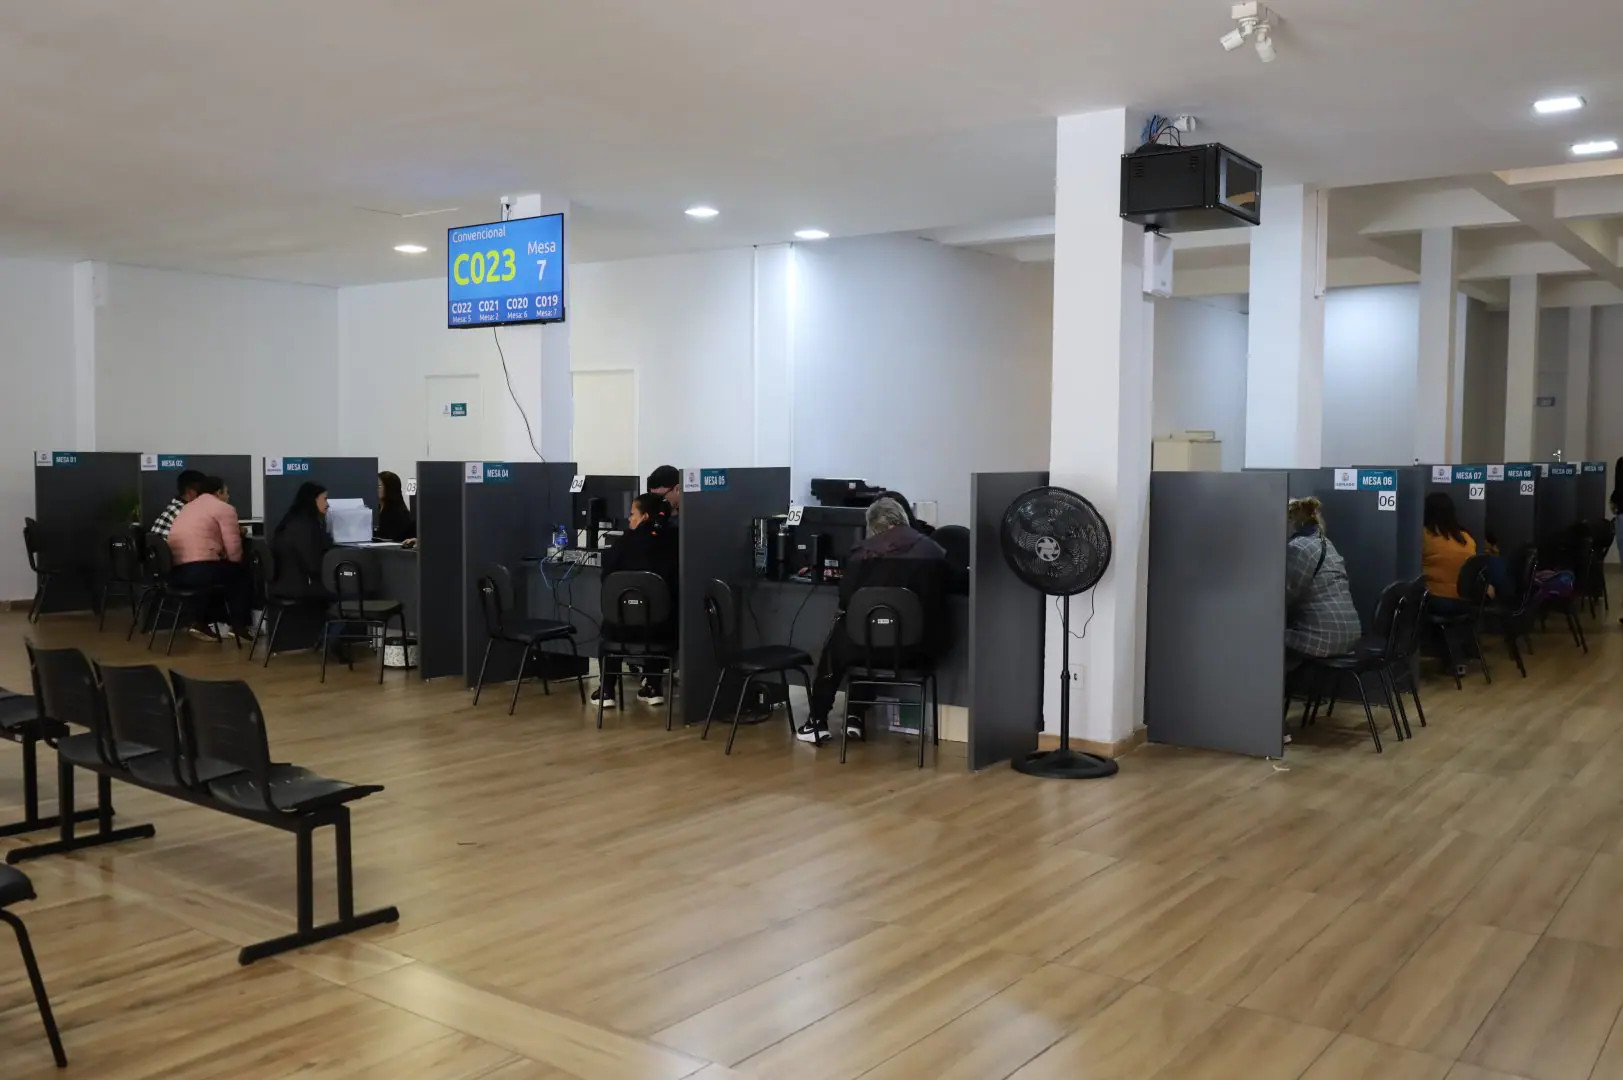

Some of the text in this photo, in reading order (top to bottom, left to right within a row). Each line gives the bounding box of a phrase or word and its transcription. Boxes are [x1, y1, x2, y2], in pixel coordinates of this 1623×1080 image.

[452, 224, 506, 243] Convencional
[527, 240, 556, 256] Mesa
[453, 248, 516, 286] C023
[536, 259, 547, 281] 7
[479, 300, 499, 312] C021
[506, 297, 529, 310] C020
[535, 294, 559, 308] C019
[451, 302, 472, 314] C022
[536, 309, 553, 317] Mesa:
[507, 311, 522, 320] Mesa:
[161, 459, 183, 467] MESA 02
[286, 463, 302, 471] MESA
[302, 463, 309, 471] 03
[487, 468, 501, 478] MESA
[502, 468, 509, 478] 04
[1455, 472, 1473, 480] MESA
[1473, 471, 1482, 480] 07
[571, 480, 583, 489] 04
[704, 476, 717, 486] MESA
[718, 475, 725, 486] 05
[1362, 476, 1382, 486] MESA
[1382, 476, 1393, 486] 06
[407, 482, 416, 493] 03
[1470, 487, 1484, 497] 07
[1521, 483, 1534, 493] 08
[1379, 495, 1395, 507] 06
[788, 510, 802, 522] 05
